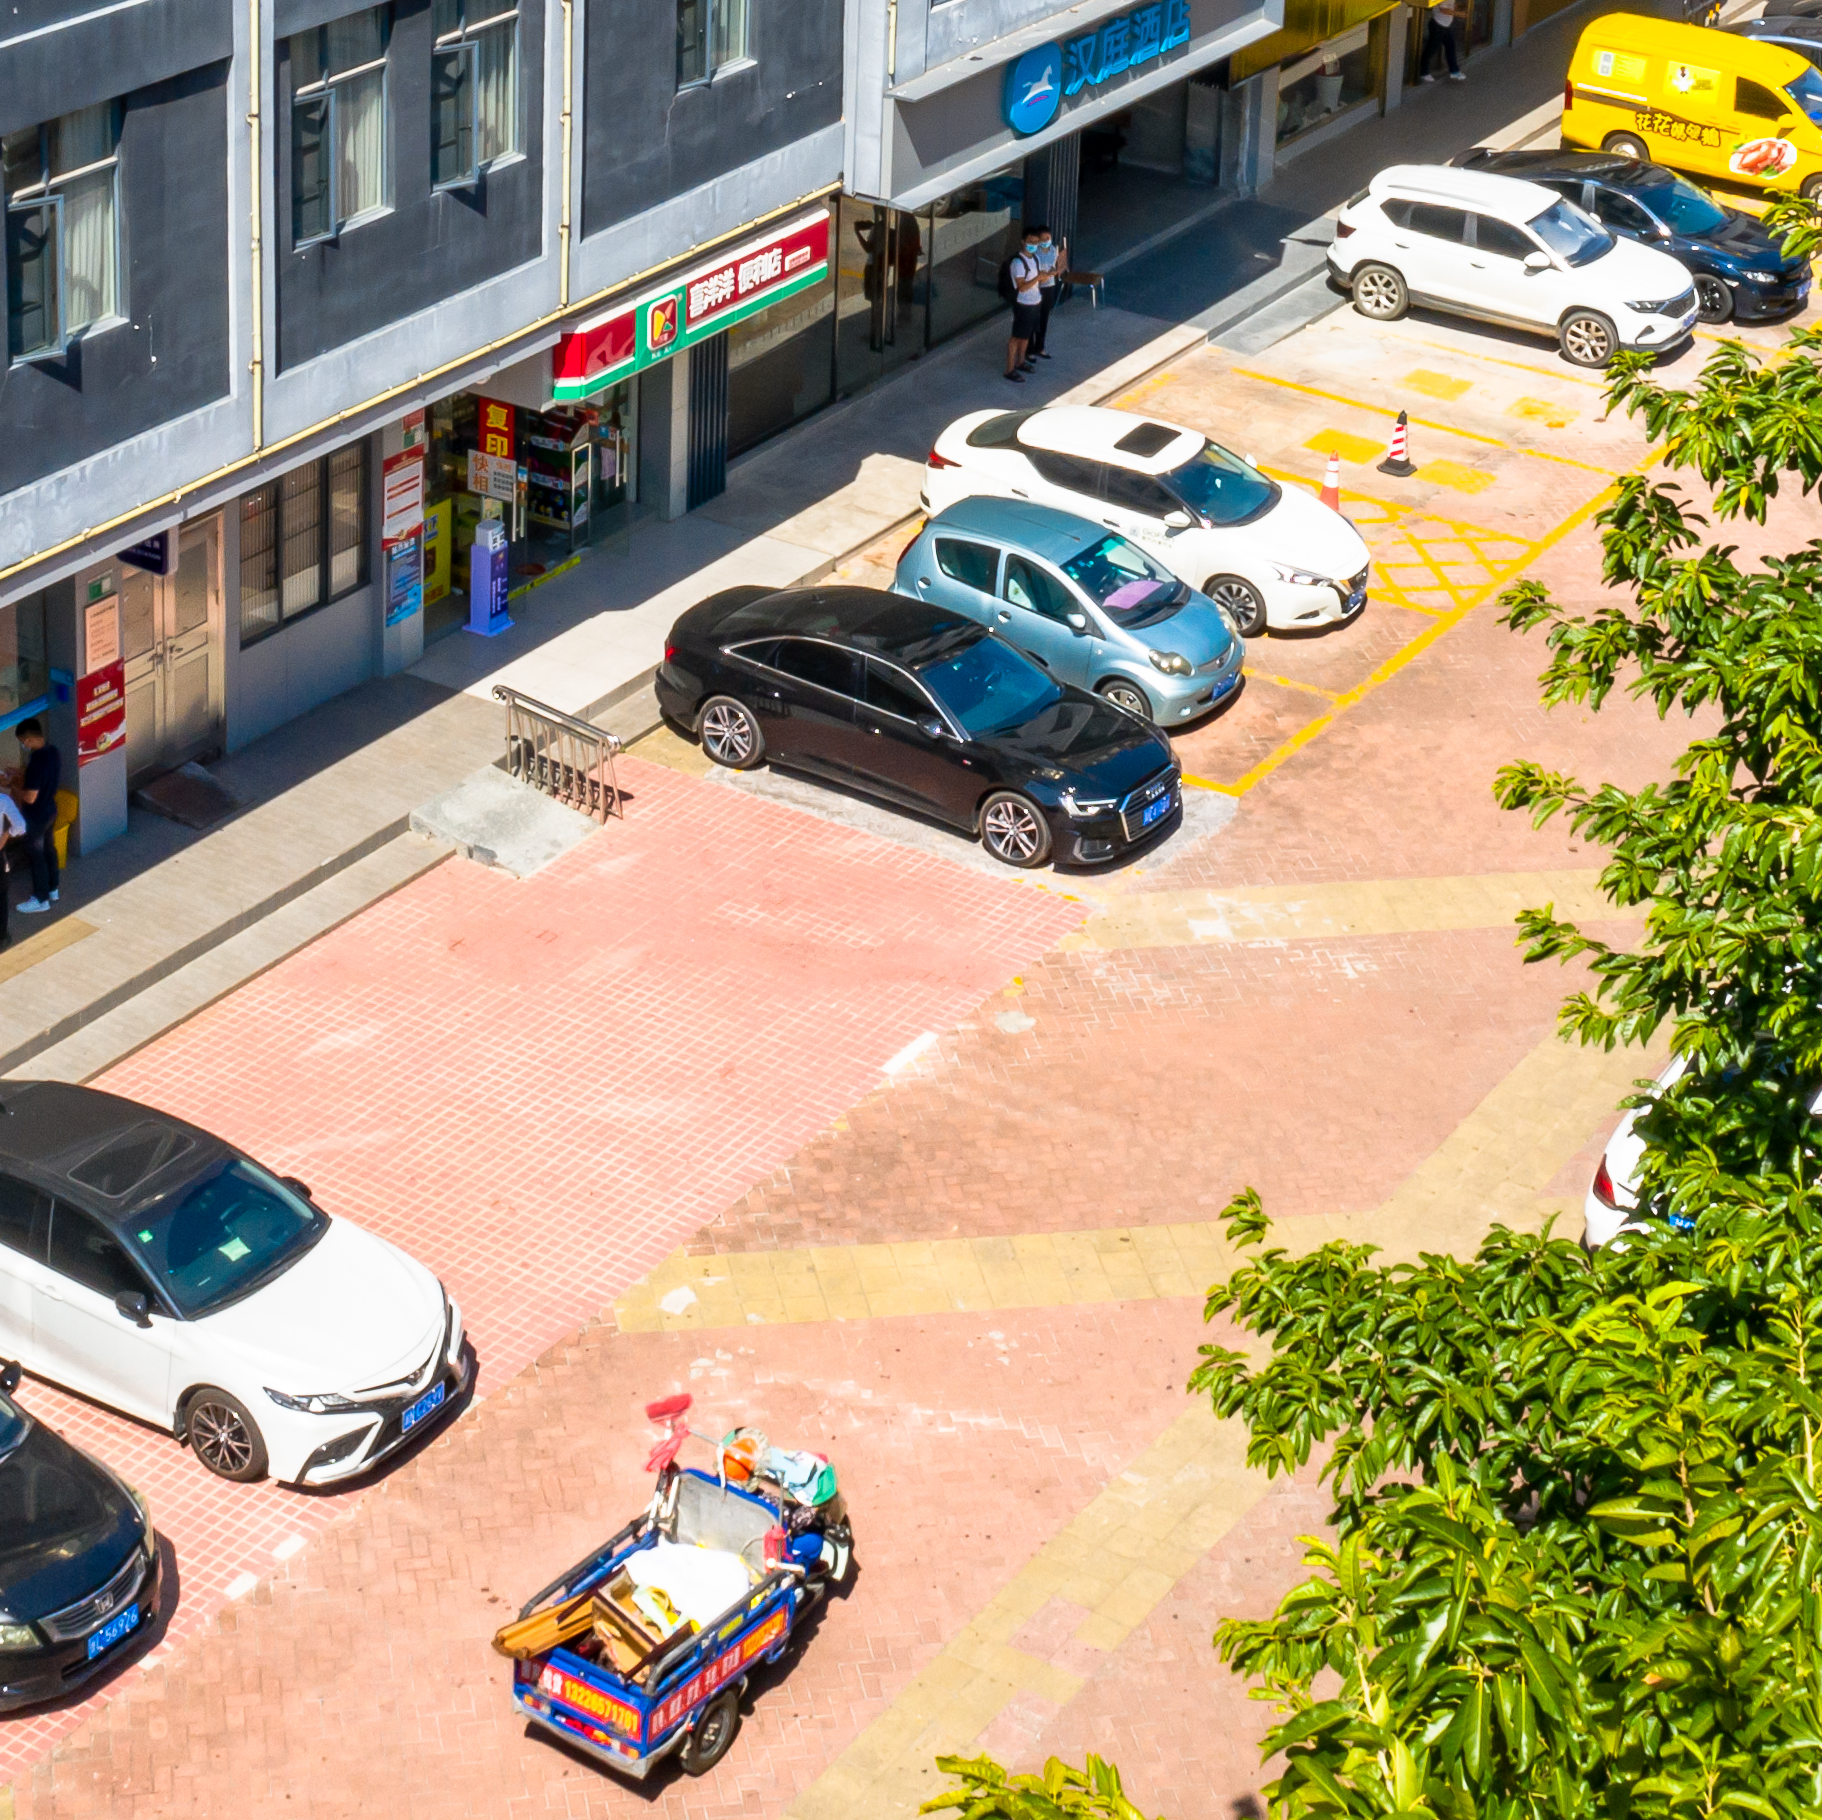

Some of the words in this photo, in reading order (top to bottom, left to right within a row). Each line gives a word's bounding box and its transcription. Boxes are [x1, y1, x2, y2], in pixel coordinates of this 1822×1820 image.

[688, 267, 736, 320] 喜洋洋
[737, 247, 783, 295] 便利店
[485, 403, 510, 457] 复印
